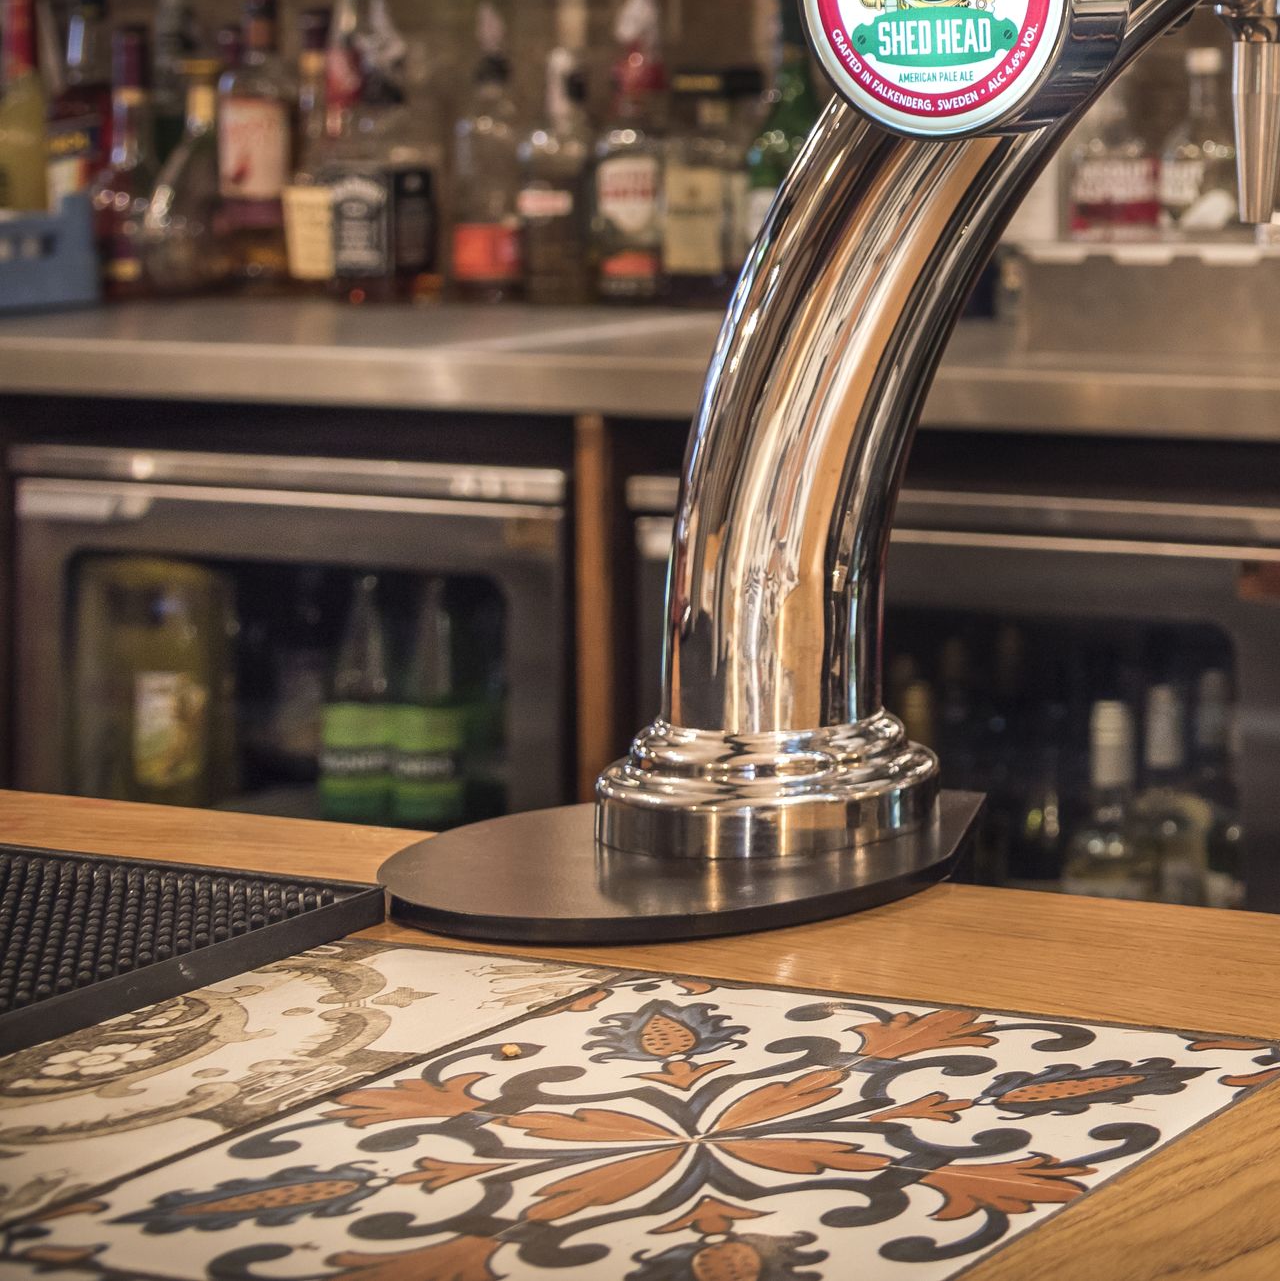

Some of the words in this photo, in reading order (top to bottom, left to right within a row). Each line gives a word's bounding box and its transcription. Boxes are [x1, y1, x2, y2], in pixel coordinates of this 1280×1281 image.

[878, 19, 932, 56] SHED
[936, 17, 992, 54] HEAD
[987, 71, 1006, 93] ALC
[1005, 49, 1026, 75] 4.6%
[1020, 23, 1039, 48] VOL.
[832, 28, 862, 73] CRAFTED
[860, 70, 873, 85] IN
[937, 90, 979, 111] SWEDEN
[898, 72, 937, 83] AMERICAN
[939, 71, 957, 82] PALE
[959, 70, 974, 81] ALE
